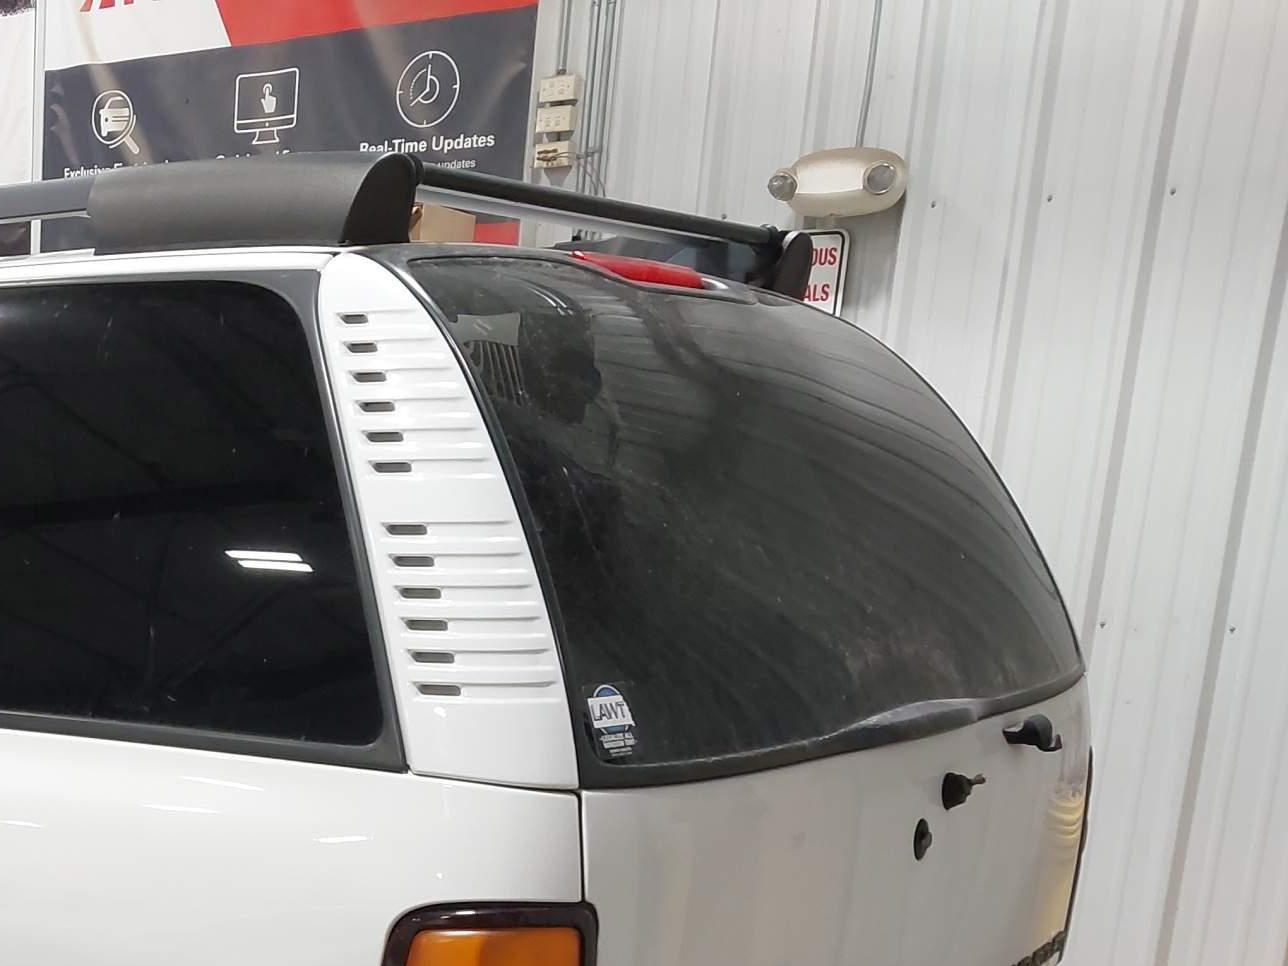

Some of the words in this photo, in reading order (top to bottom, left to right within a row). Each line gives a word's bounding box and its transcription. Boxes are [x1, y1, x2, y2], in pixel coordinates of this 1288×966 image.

[360, 139, 427, 153] Real-Time
[432, 134, 495, 153] Updates
[812, 247, 837, 266] OUS
[801, 283, 830, 302] ALS
